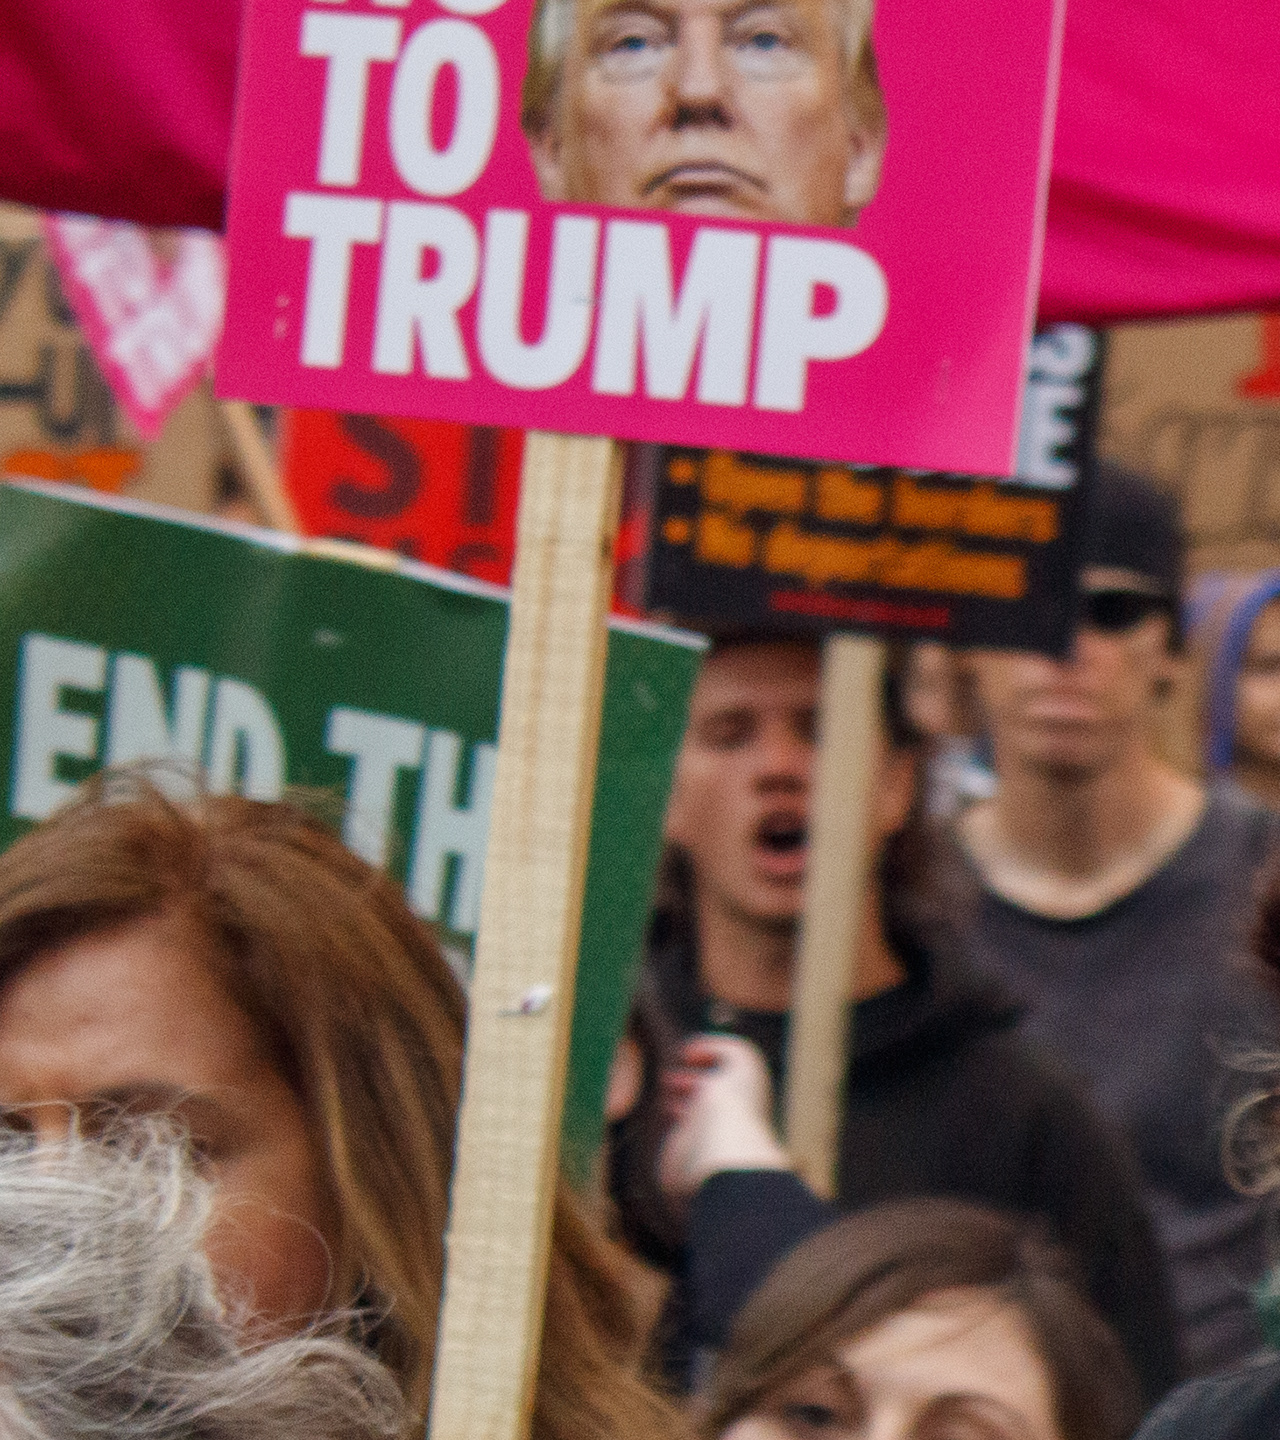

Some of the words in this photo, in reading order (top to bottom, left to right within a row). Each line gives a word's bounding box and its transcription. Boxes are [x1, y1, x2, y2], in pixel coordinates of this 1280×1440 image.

[300, 10, 500, 197] TO
[283, 193, 889, 412] TRUMP
[11, 631, 287, 822] END
